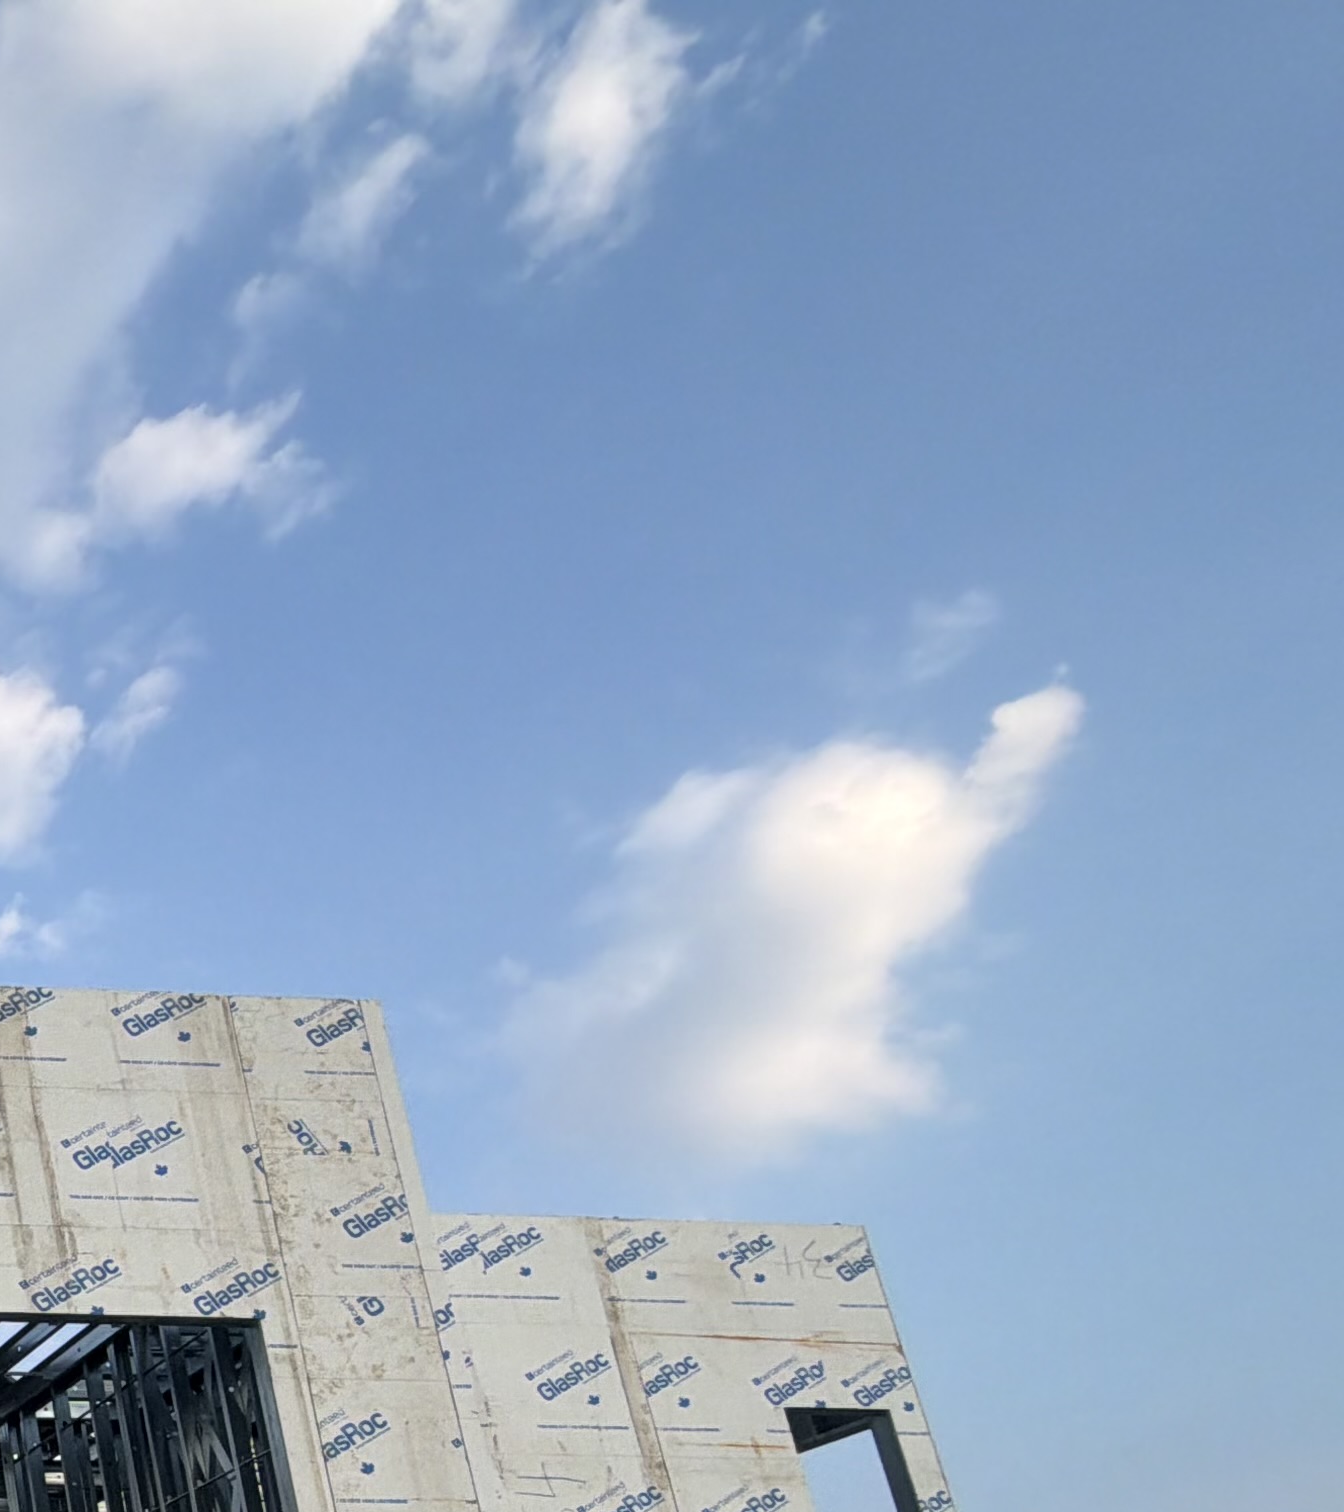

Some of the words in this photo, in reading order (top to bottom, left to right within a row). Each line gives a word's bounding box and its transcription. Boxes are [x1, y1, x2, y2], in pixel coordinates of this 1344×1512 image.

[306, 1009, 365, 1048] GlasR
[342, 1194, 409, 1239] GlasRo
[484, 1227, 542, 1268] lasRoc
[837, 1252, 874, 1282] Glas
[31, 1257, 121, 1313] GlasRoc
[193, 1262, 280, 1317] GlasRoc
[537, 1353, 610, 1401] GlasRoc
[645, 1356, 700, 1398] lasRoc
[854, 1364, 910, 1407] GlasRo
[323, 1413, 389, 1462] asRoc
